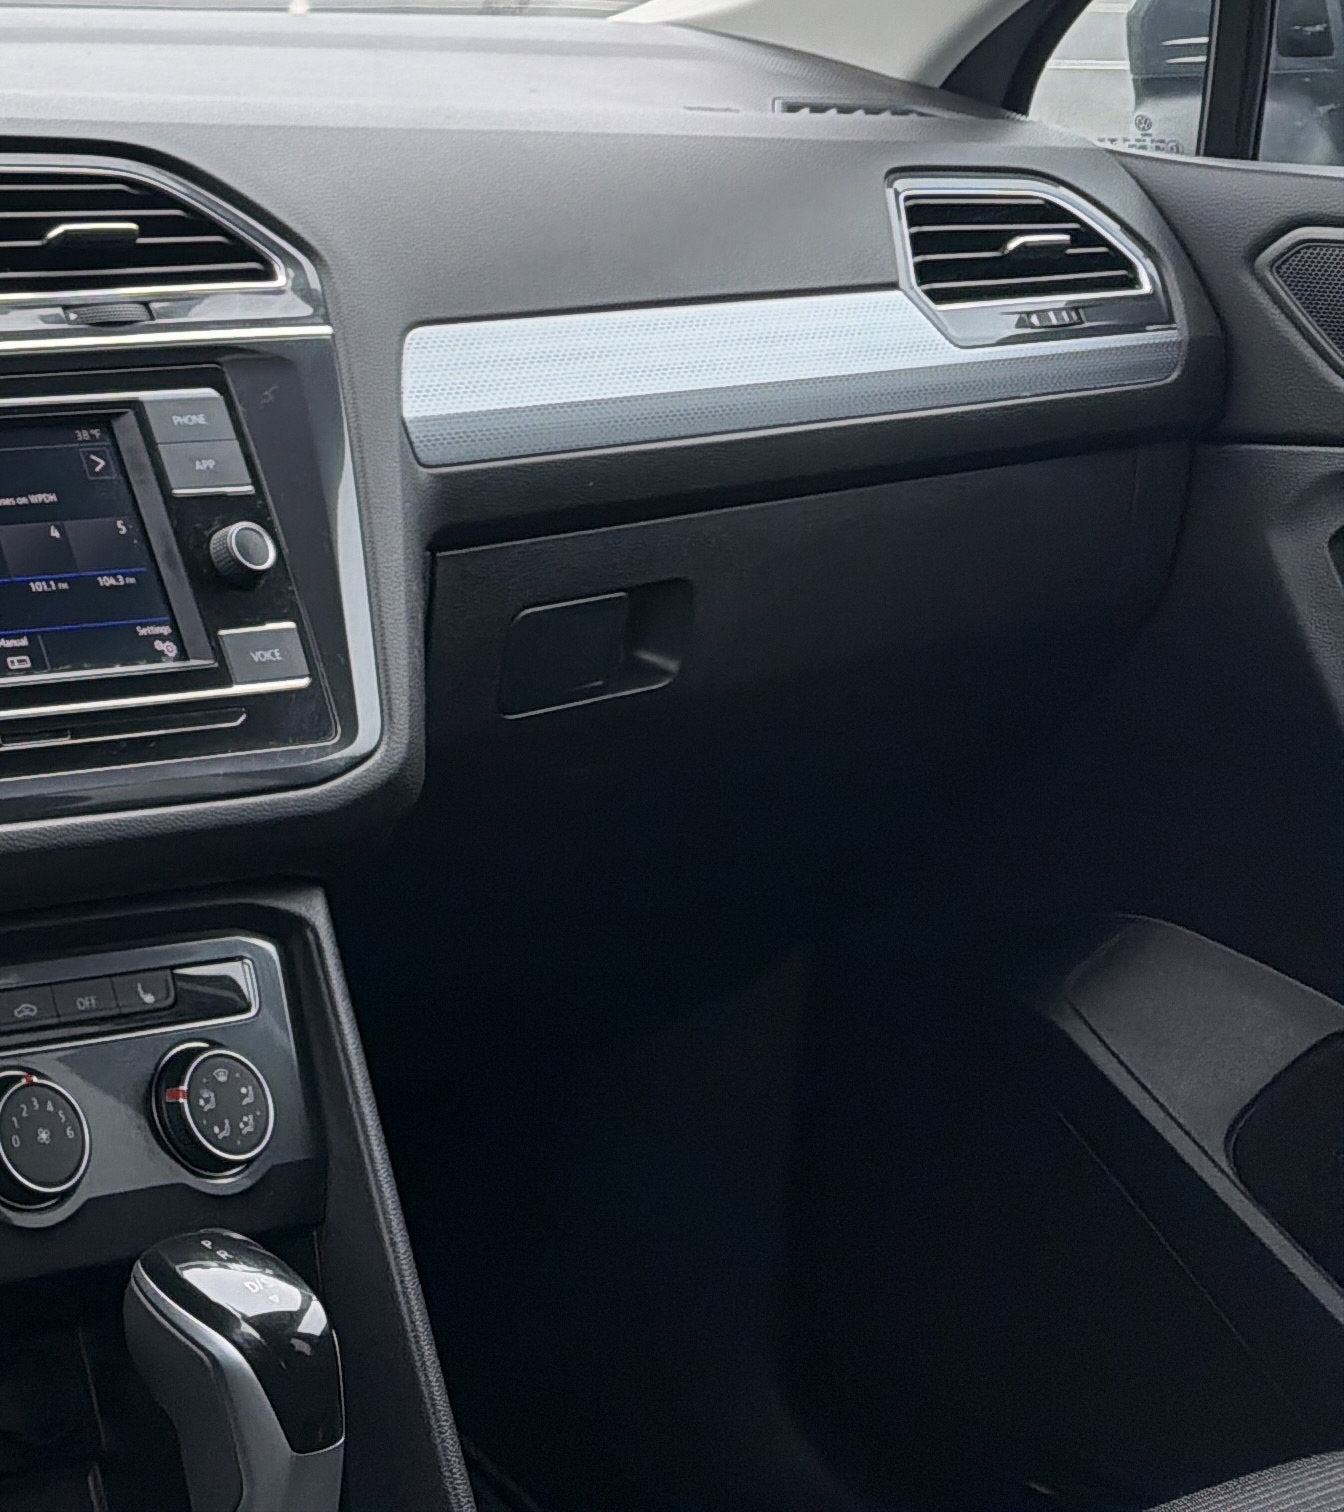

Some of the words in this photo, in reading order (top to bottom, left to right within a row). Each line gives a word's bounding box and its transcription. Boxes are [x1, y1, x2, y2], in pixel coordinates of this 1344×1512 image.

[172, 413, 208, 426] PHONE
[50, 525, 61, 539] 4
[116, 521, 127, 535] 5
[29, 580, 57, 592] 101.1
[135, 625, 173, 637] Settings
[250, 649, 283, 662] VOICE
[75, 996, 97, 1011] OFF
[20, 1104, 29, 1117] 2
[31, 1096, 39, 1110] 3
[46, 1100, 54, 1112] 4
[58, 1110, 66, 1123] 5
[66, 1126, 75, 1139] 6
[200, 1239, 213, 1249] P
[216, 1249, 234, 1260] R
